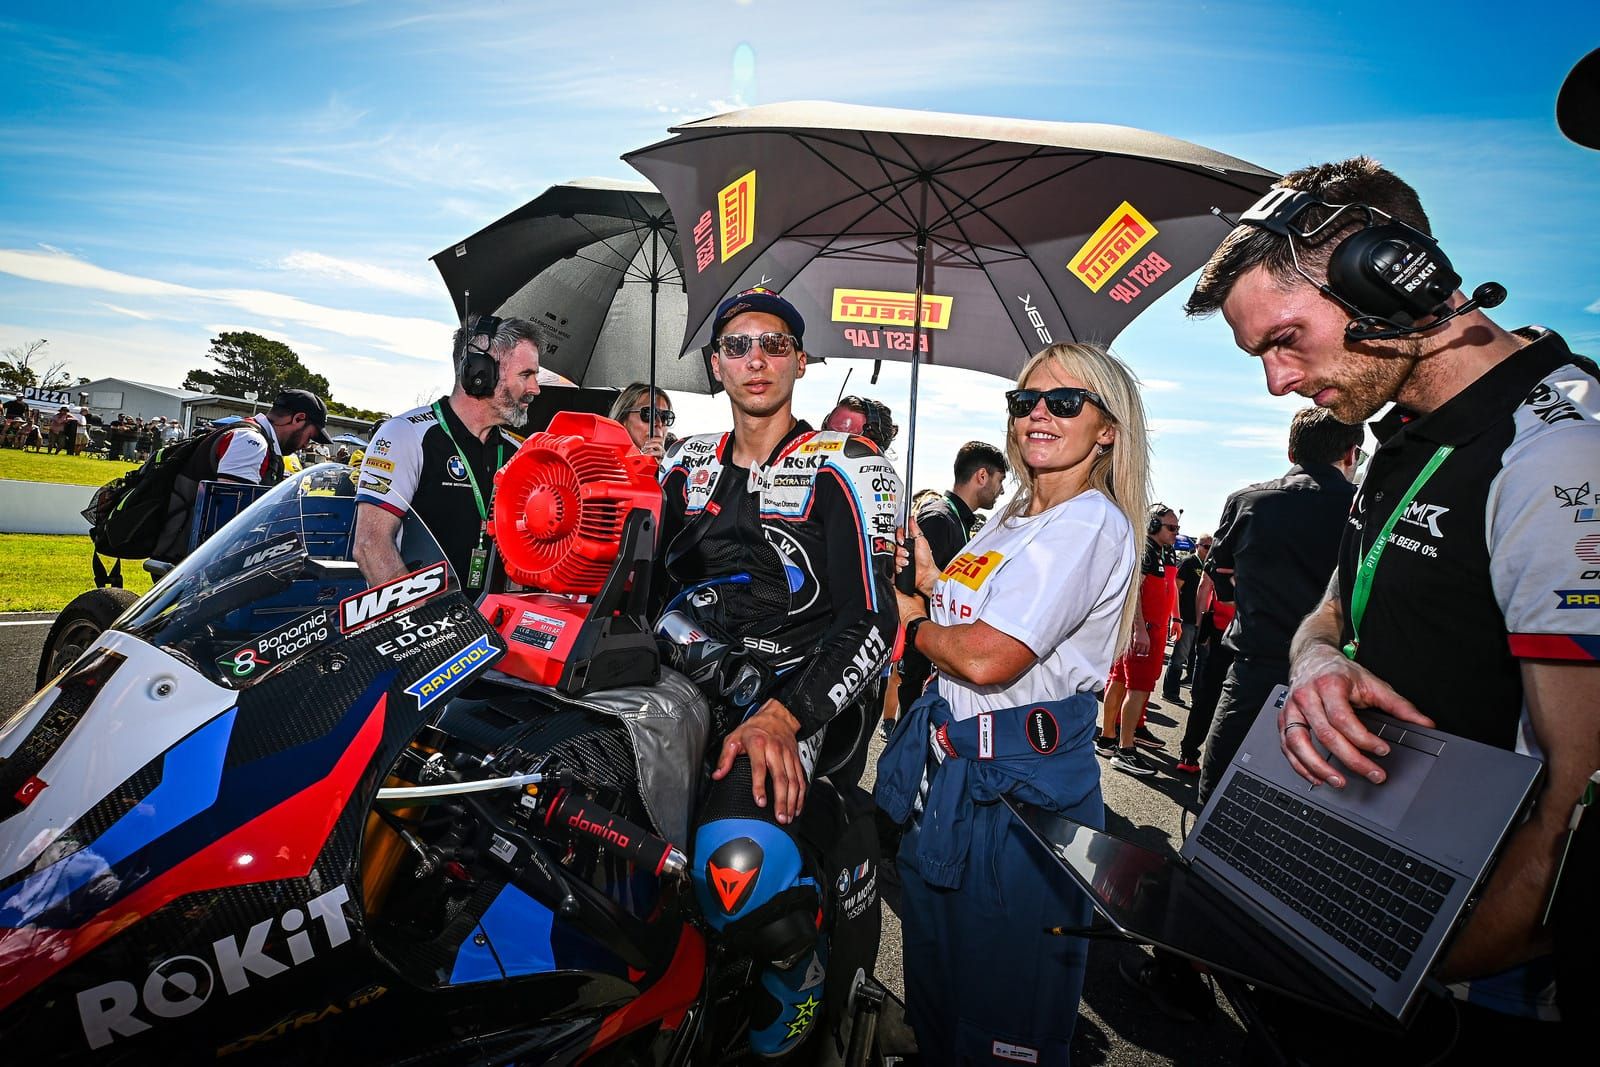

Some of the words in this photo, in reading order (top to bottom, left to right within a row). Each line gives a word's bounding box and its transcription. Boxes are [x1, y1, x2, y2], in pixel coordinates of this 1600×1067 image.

[24, 387, 70, 405] PIZZA
[872, 473, 897, 493] ebc
[242, 538, 298, 569] WRS
[1366, 555, 1377, 569] PIT
[1375, 535, 1387, 555] LANE
[1396, 535, 1422, 552] BEER
[1421, 544, 1438, 559] 0%
[346, 566, 445, 628] WRS
[258, 610, 328, 654] Bonamici
[276, 626, 328, 660] Racing
[375, 616, 456, 657] EDOX
[392, 643, 422, 662] Swiss
[420, 630, 458, 654] Watches
[420, 644, 490, 698] RAVENOL
[569, 809, 630, 848] domino
[530, 851, 552, 881] domino
[76, 883, 351, 1050] ROKiT
